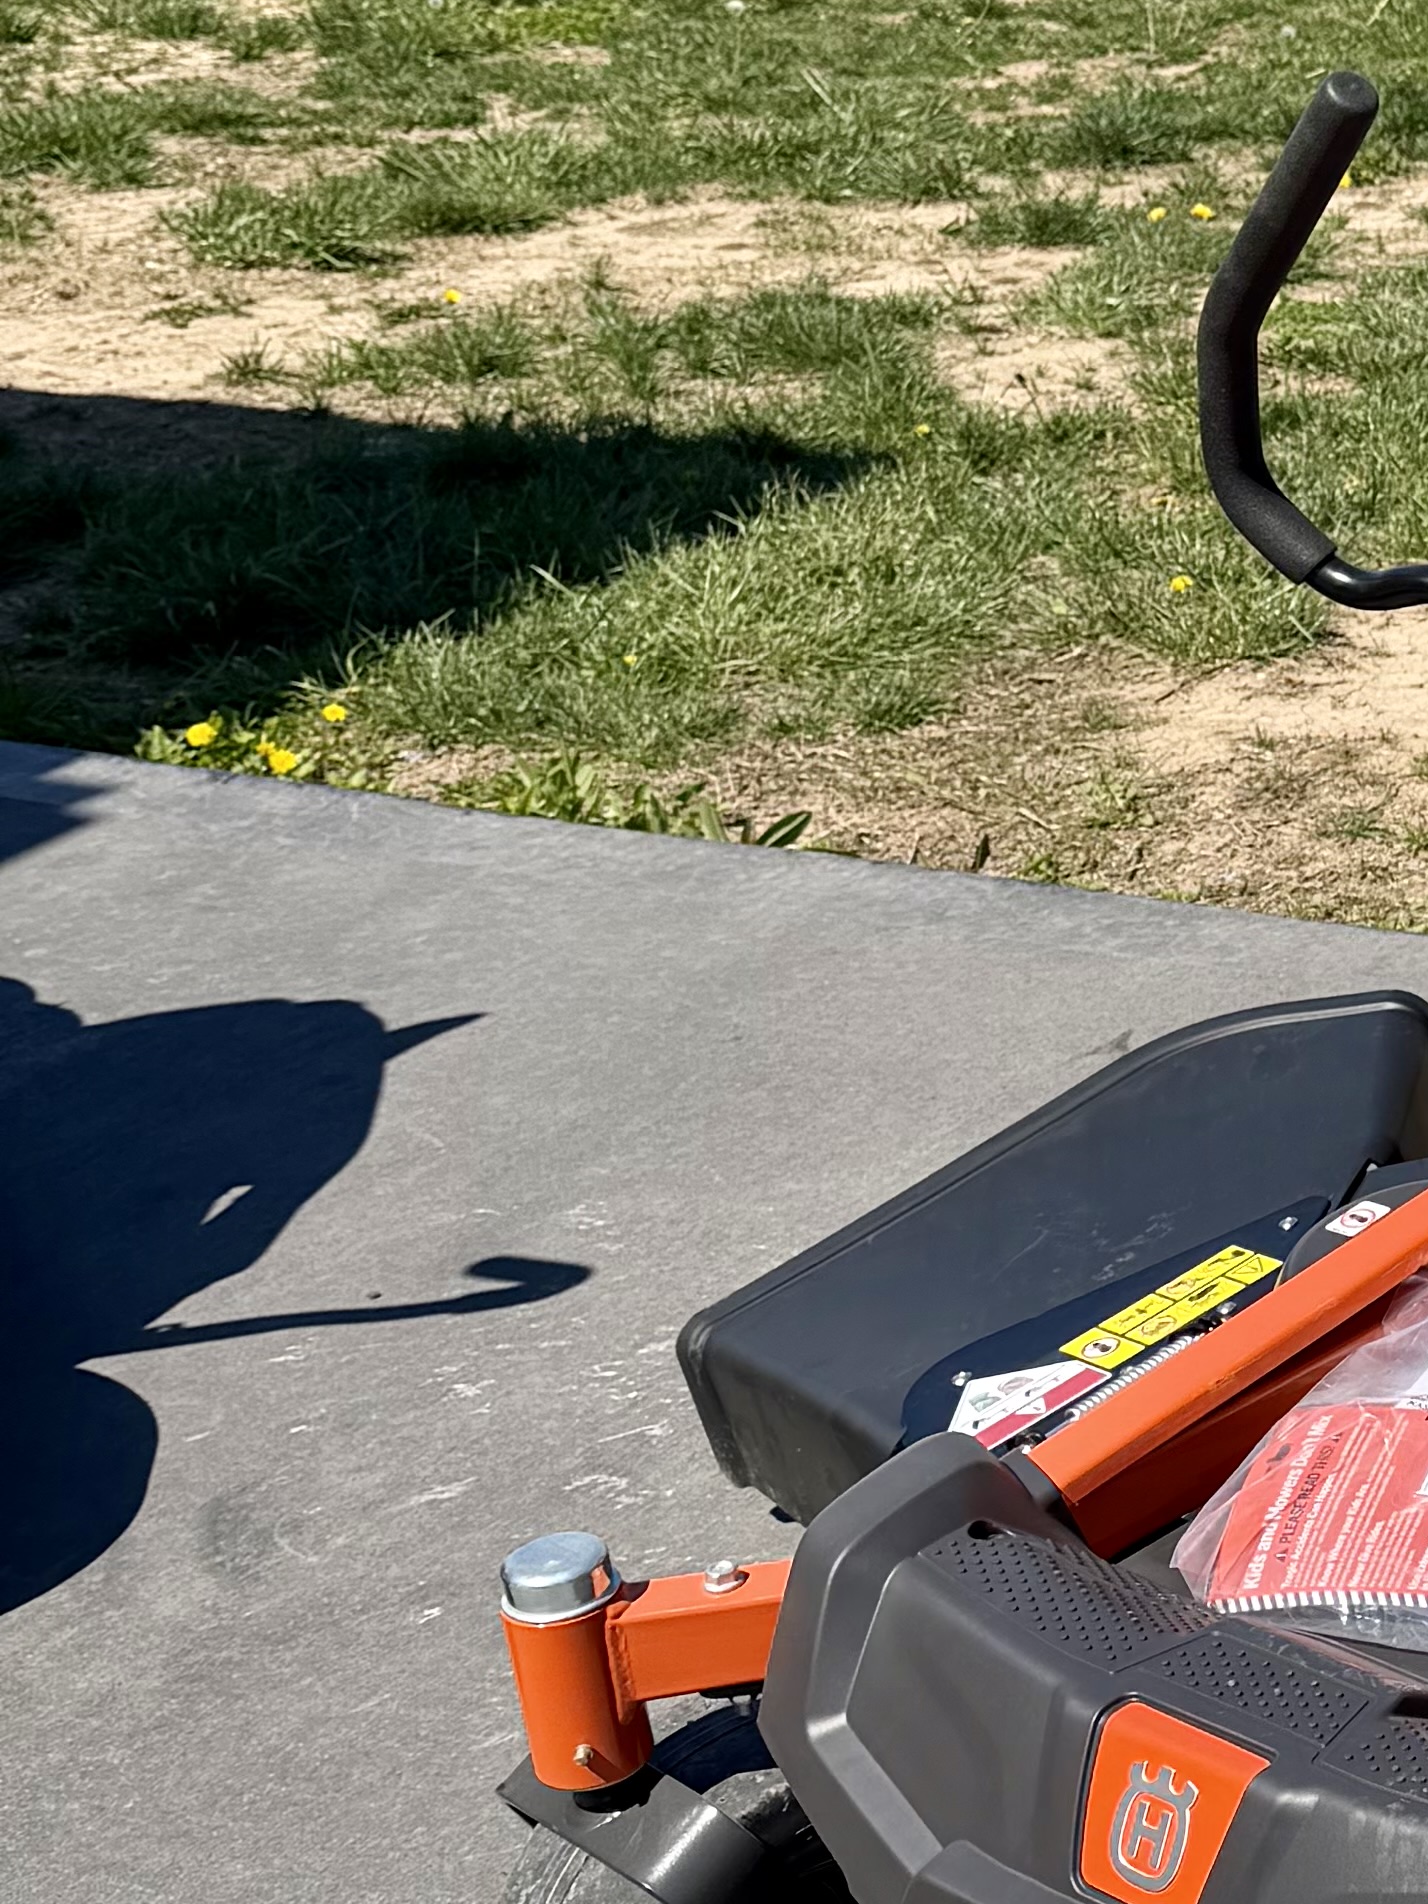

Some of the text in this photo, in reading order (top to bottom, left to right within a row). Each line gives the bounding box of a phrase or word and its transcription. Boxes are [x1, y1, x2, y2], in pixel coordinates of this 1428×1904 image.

[1307, 1414, 1334, 1437] Mix
[1264, 1468, 1304, 1521] Mowers
[1279, 1445, 1336, 1544] PLEASE READ THIS!
[1257, 1521, 1279, 1552] and
[1242, 1553, 1268, 1590] Kids
